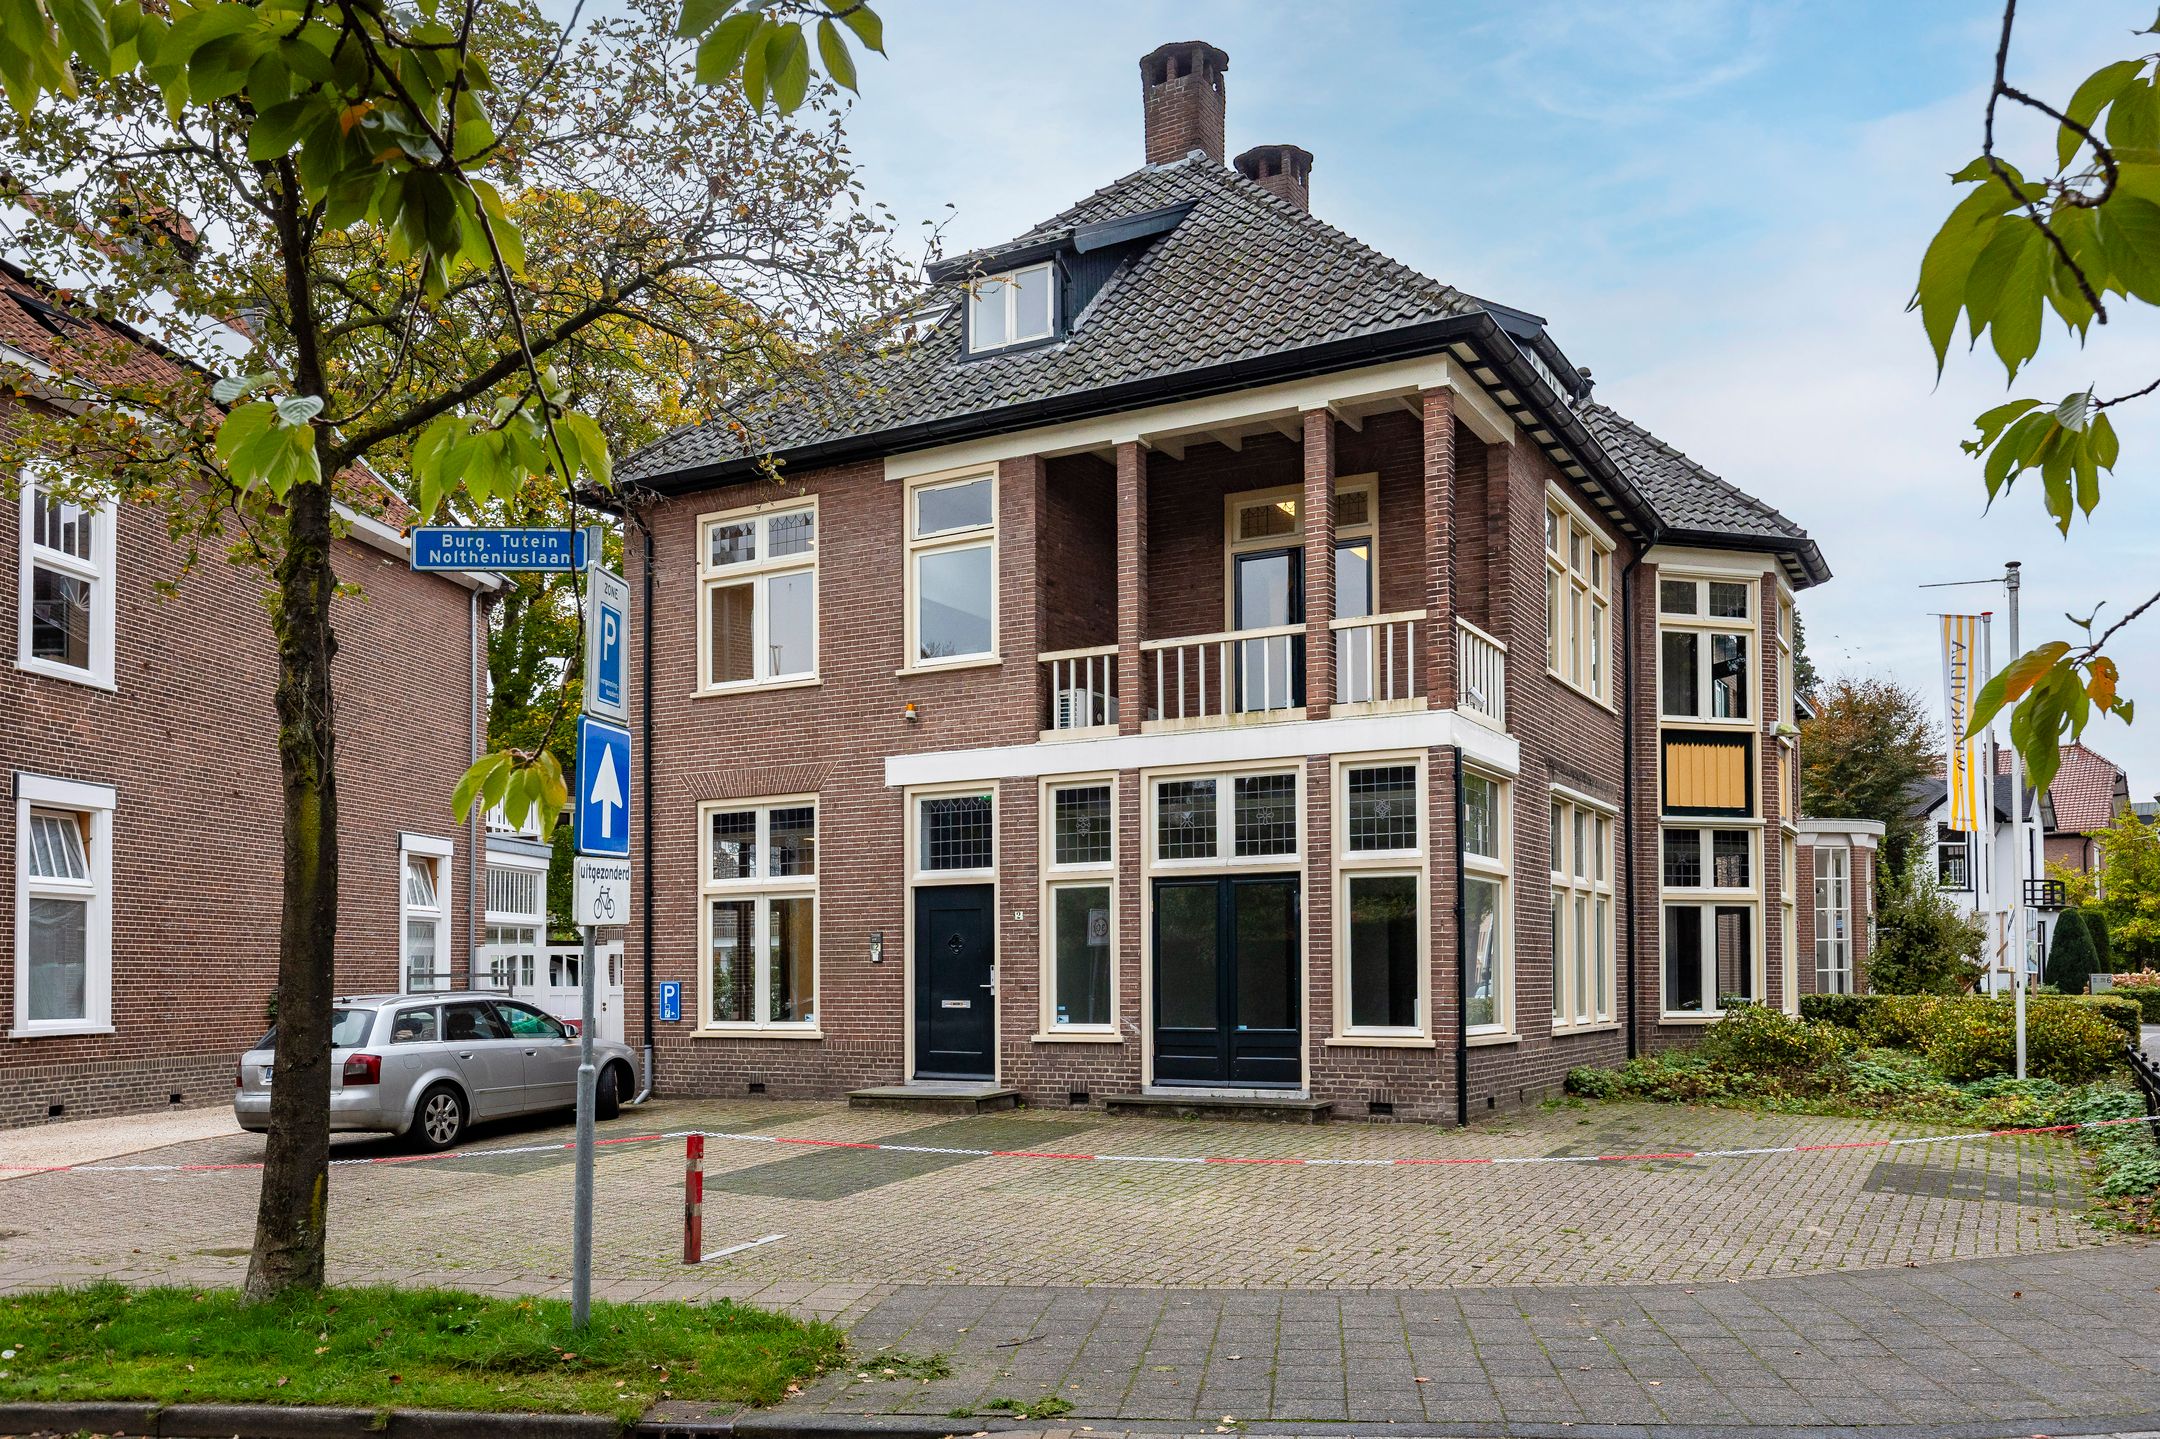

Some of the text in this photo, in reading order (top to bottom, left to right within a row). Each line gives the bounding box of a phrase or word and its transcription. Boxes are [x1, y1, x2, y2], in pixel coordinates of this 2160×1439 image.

[442, 534, 558, 552] Burg. Tutein
[430, 550, 571, 564] Noltheniuslaan
[604, 582, 618, 600] ZONE
[604, 613, 616, 661] P
[581, 863, 629, 884] uitgezonderd
[664, 985, 676, 1004] P
